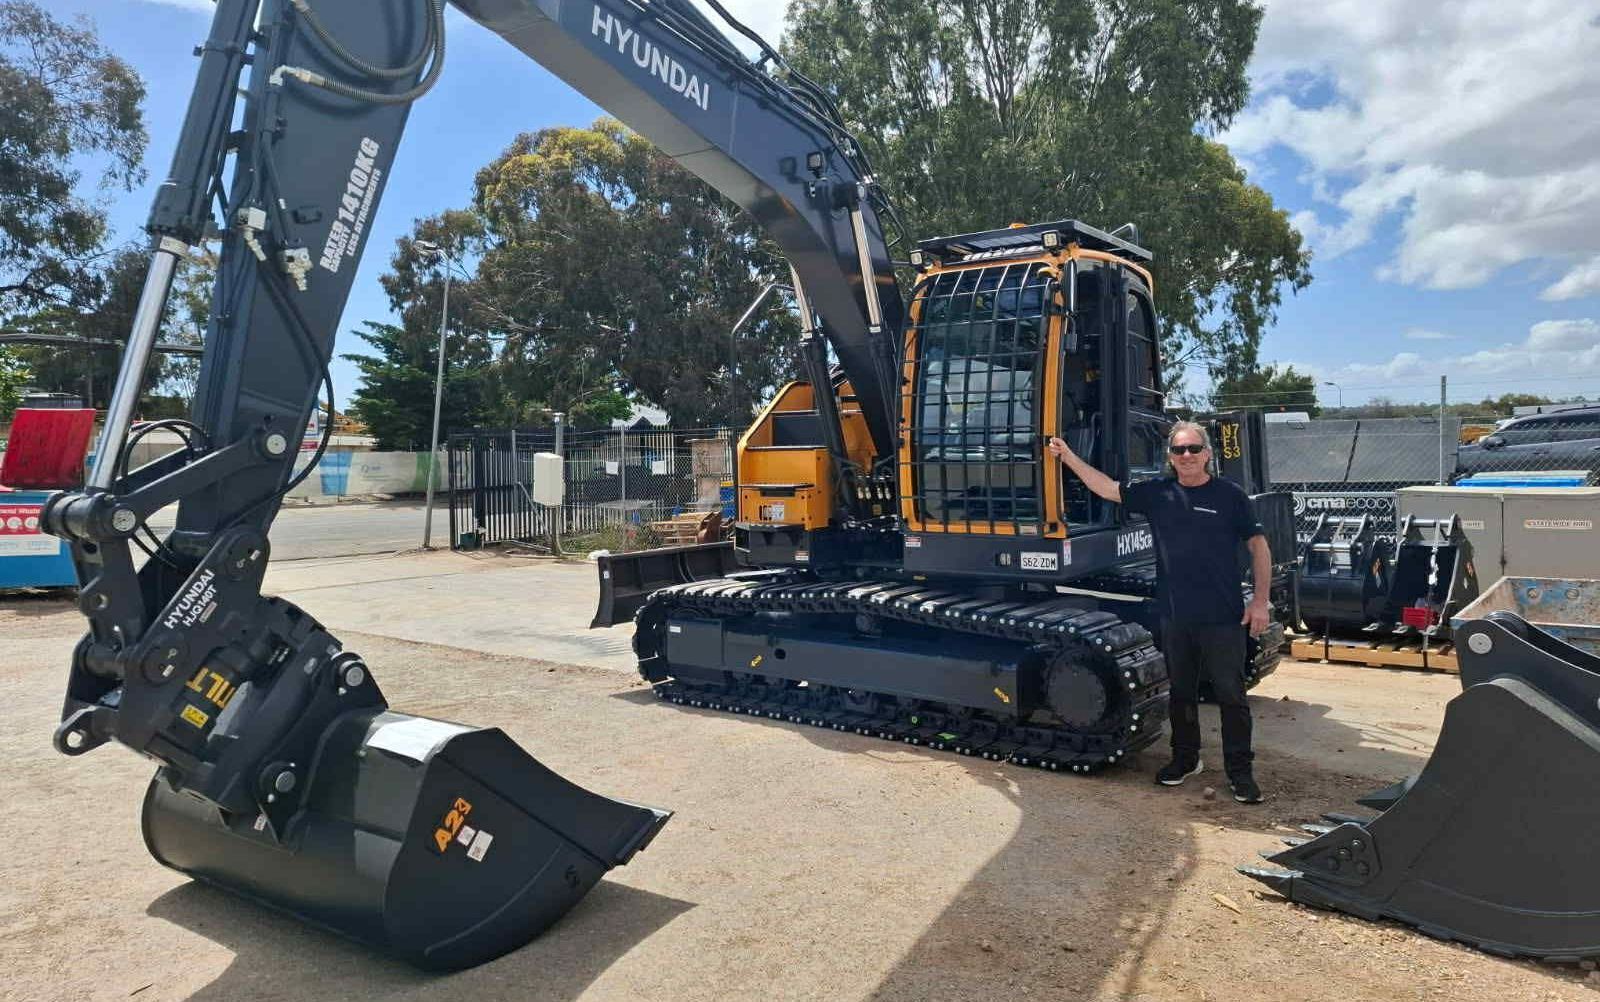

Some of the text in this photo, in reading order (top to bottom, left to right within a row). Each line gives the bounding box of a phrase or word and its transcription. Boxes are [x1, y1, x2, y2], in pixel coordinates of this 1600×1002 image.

[592, 5, 709, 110] HYUNDAI
[339, 137, 380, 223] 1410KG
[346, 232, 360, 257] LESS
[1023, 557, 1057, 569] S62 ZDM
[164, 568, 215, 629] HYUNDAI
[182, 584, 217, 627] HJQ140T
